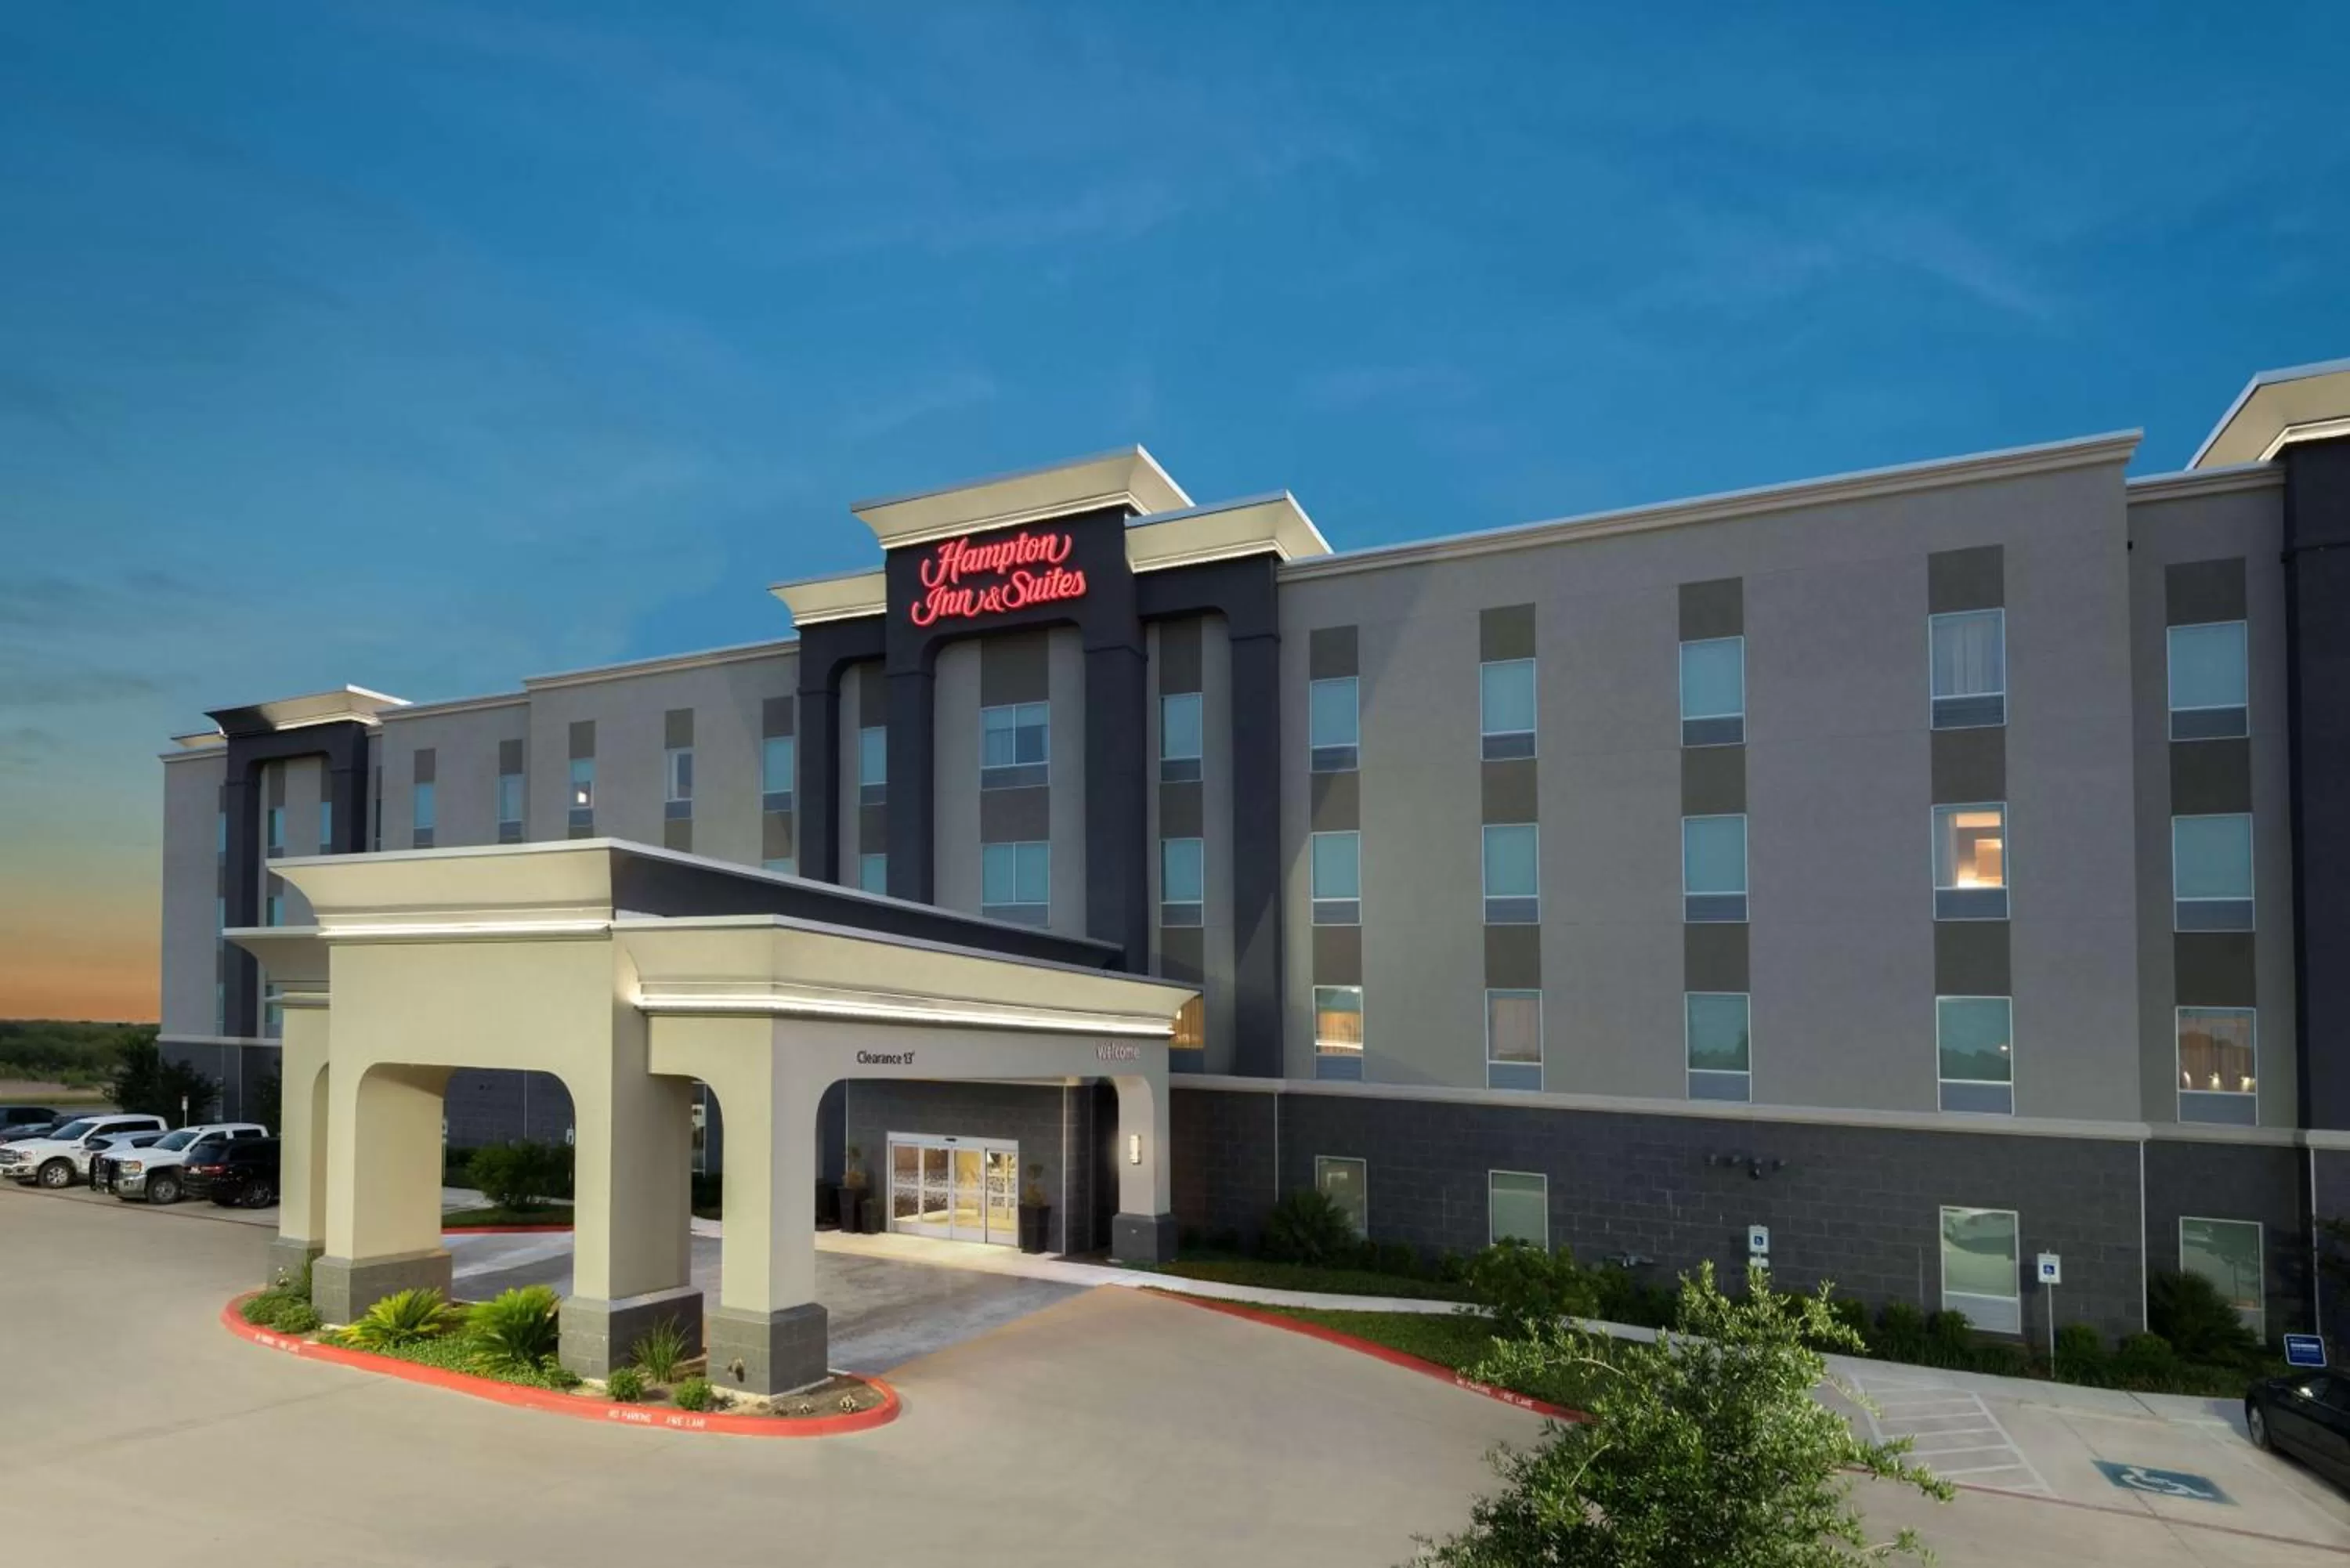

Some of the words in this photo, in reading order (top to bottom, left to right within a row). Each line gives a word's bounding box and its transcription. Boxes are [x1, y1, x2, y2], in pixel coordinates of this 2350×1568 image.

[920, 531, 1072, 589] Hampton
[911, 584, 985, 627] Inn
[984, 585, 1006, 612] &
[1001, 566, 1087, 609] Suites
[856, 1050, 902, 1064] Clearance
